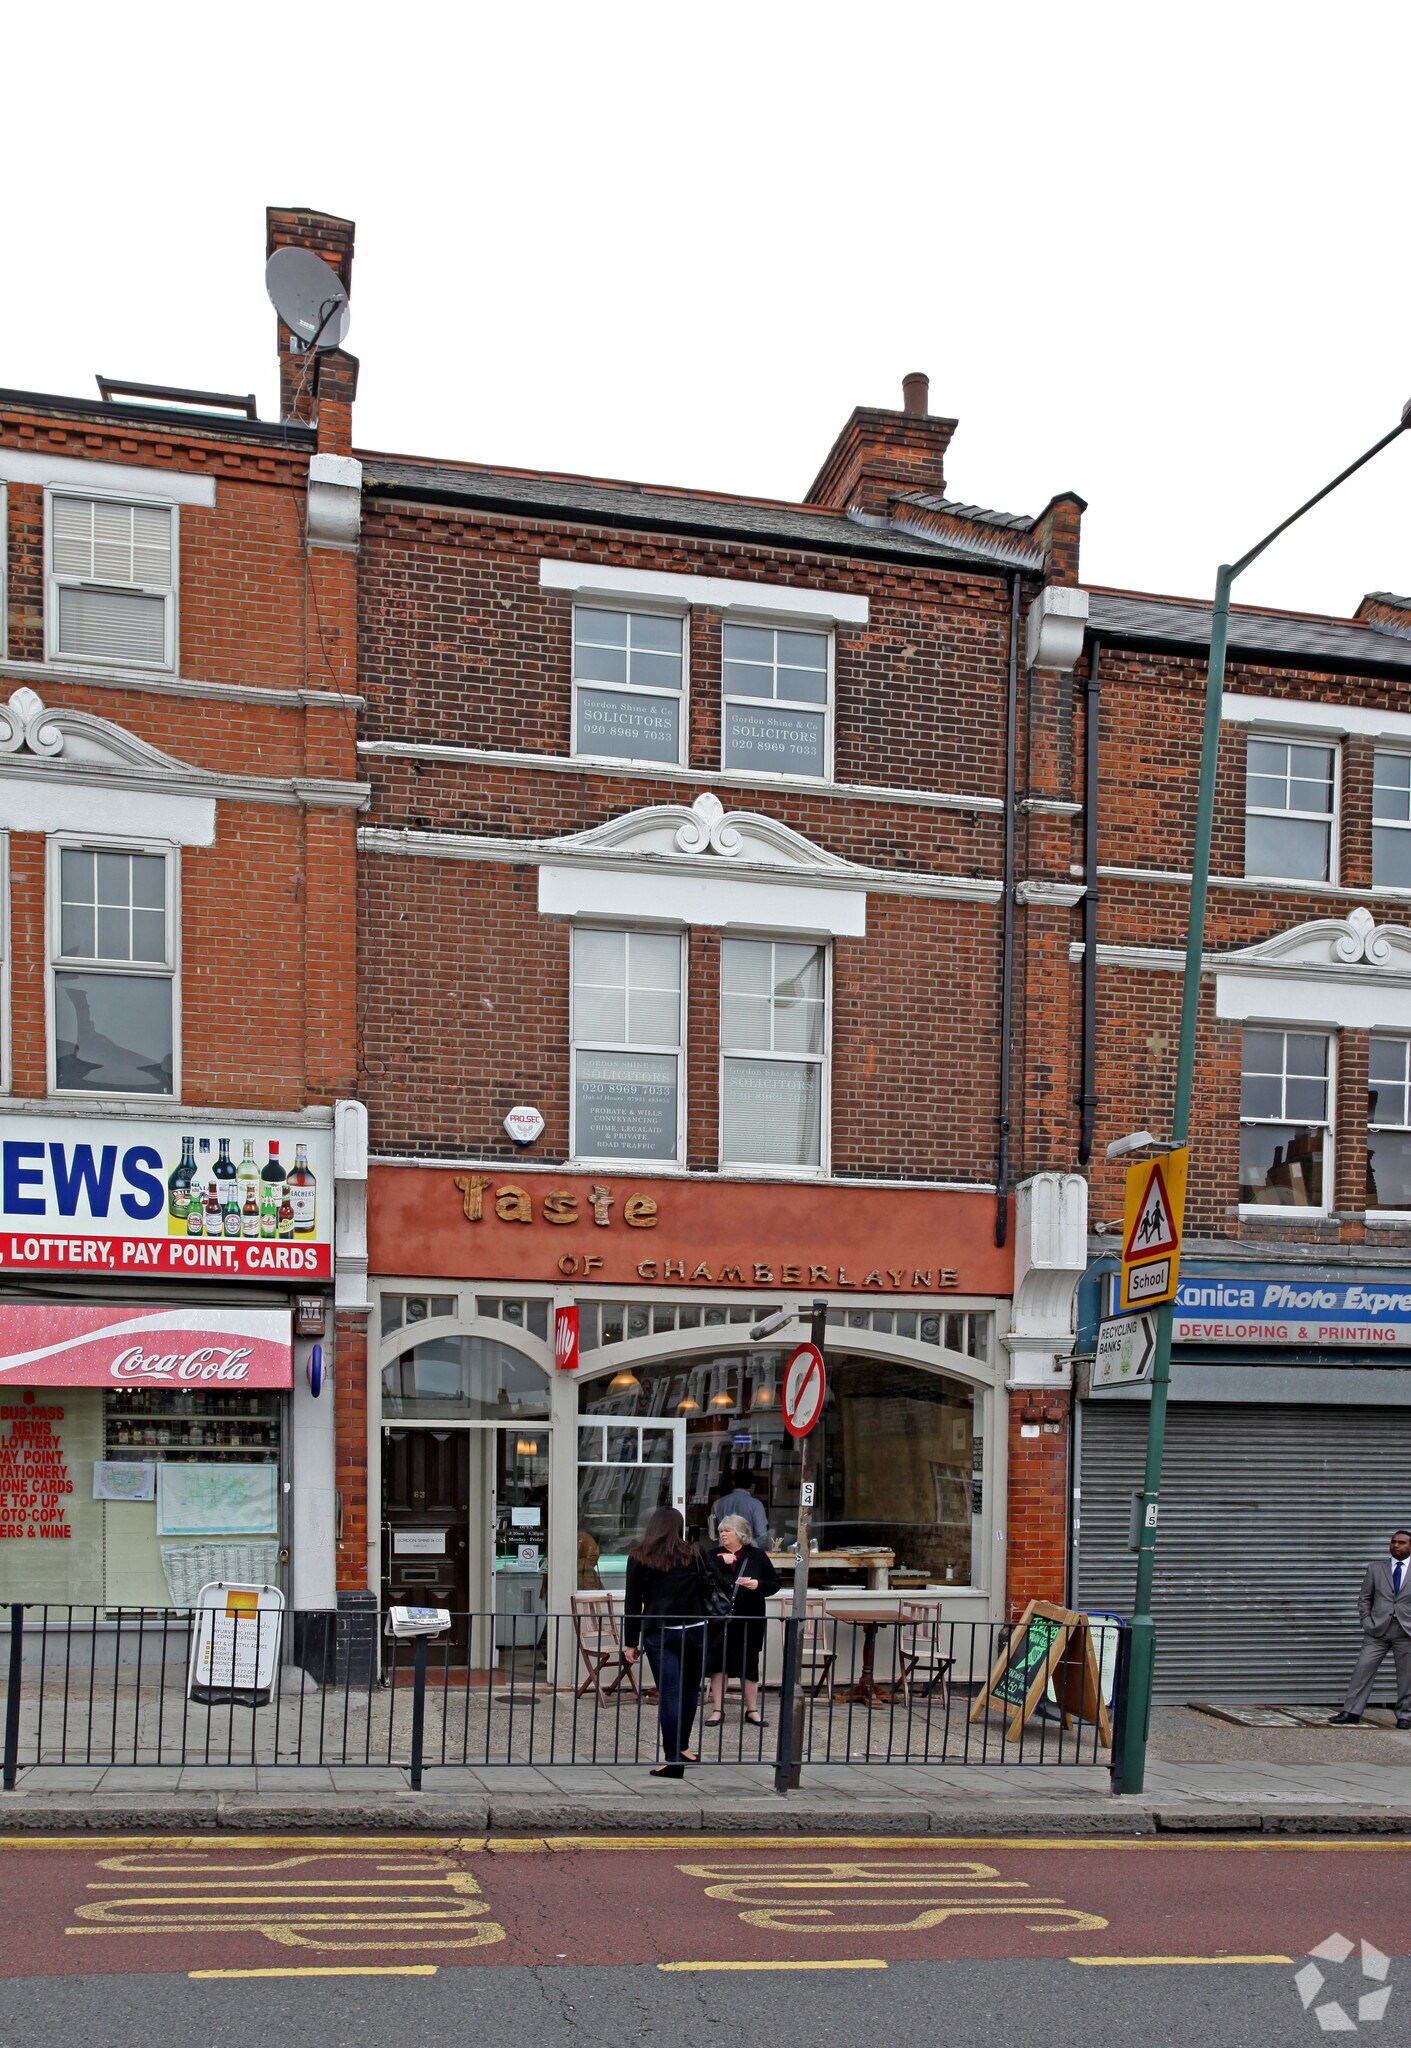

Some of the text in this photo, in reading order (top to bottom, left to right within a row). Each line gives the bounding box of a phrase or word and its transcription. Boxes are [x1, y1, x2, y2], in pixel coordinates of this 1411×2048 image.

[584, 699, 616, 709] Gordon
[620, 703, 646, 712] Shine
[650, 706, 657, 714] &
[584, 710, 672, 728] SOLICITORS
[732, 714, 764, 724] Gordon
[767, 718, 793, 727] Shine
[584, 724, 672, 742] 020 8969 7033
[732, 726, 816, 742] SOLICITORS
[732, 739, 816, 755] 020 8969 7033
[621, 1061, 648, 1069] SHINE
[583, 1070, 670, 1082] SOLICITORS
[582, 1084, 670, 1096] 020 8969 7033
[731, 1078, 814, 1090] SOLICITORS
[594, 1116, 658, 1124] CONVEYANCING
[454, 1175, 658, 1228] Taste
[11, 1237, 318, 1271] LOTTERY, PAY POINT, CARDS
[558, 1254, 960, 1288] OF CHAMBERLAYNE
[1132, 1269, 1164, 1290] School
[1262, 1284, 1337, 1309] Photo
[1101, 1321, 1137, 1340] RECYCLING
[1179, 1324, 1396, 1341] DEVELOPING & PRINTING
[556, 1316, 574, 1364] illy
[1100, 1340, 1122, 1355] BANKS
[110, 1345, 255, 1380] Coca-Cola
[1, 1406, 64, 1420] BUS-PASS
[12, 1422, 52, 1435] NEWS
[2, 1436, 61, 1449] LOTTERY
[24, 1450, 64, 1464] POINT
[0, 1480, 74, 1494] ONE CARDS
[12, 1494, 38, 1508] TOP
[42, 1494, 59, 1508] UP
[28, 1524, 36, 1538] &
[40, 1525, 72, 1538] WINE
[233, 1619, 270, 1629] Ayurvda
[64, 1853, 507, 1950] STOP
[674, 1862, 1109, 1933] BUS
